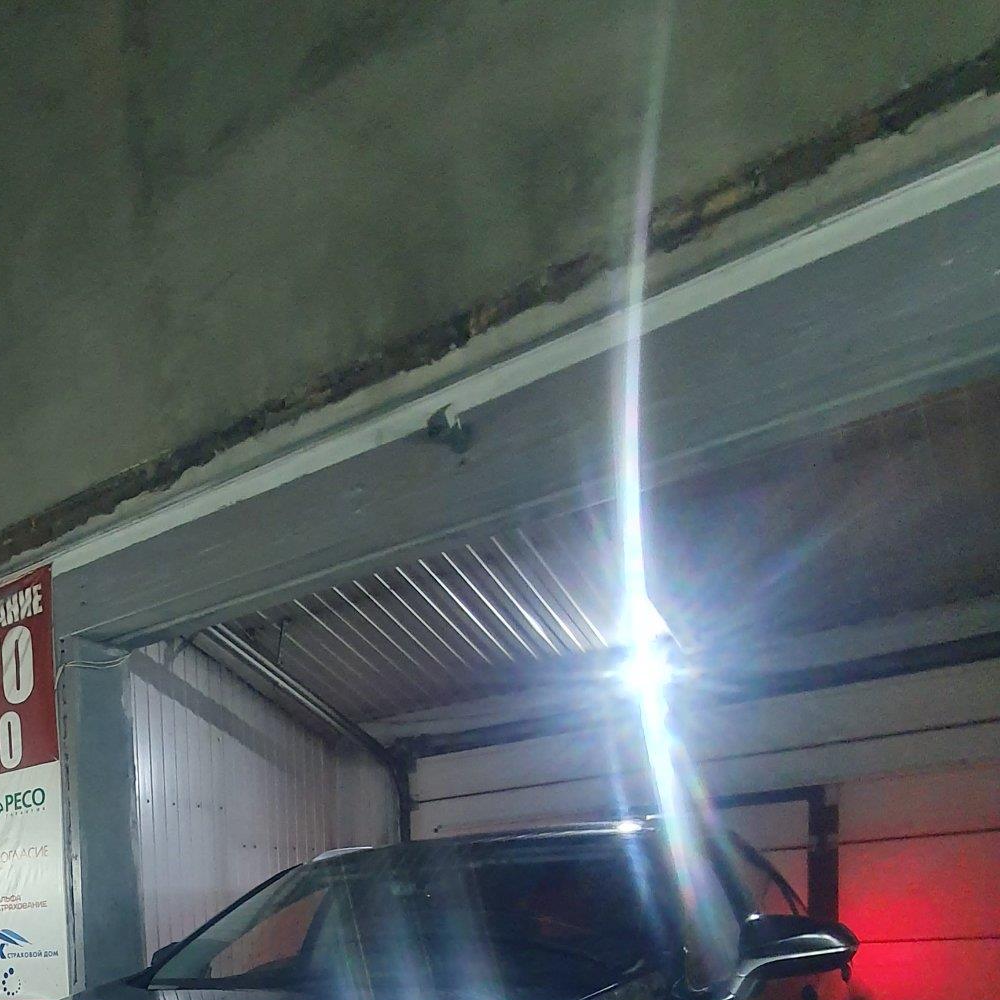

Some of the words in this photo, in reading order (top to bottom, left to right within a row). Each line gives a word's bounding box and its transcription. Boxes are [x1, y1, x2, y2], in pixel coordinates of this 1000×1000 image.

[5, 788, 46, 812] РЕСО
[7, 950, 43, 959] СТРАХОВОЙ
[43, 950, 59, 958] ДОМ
